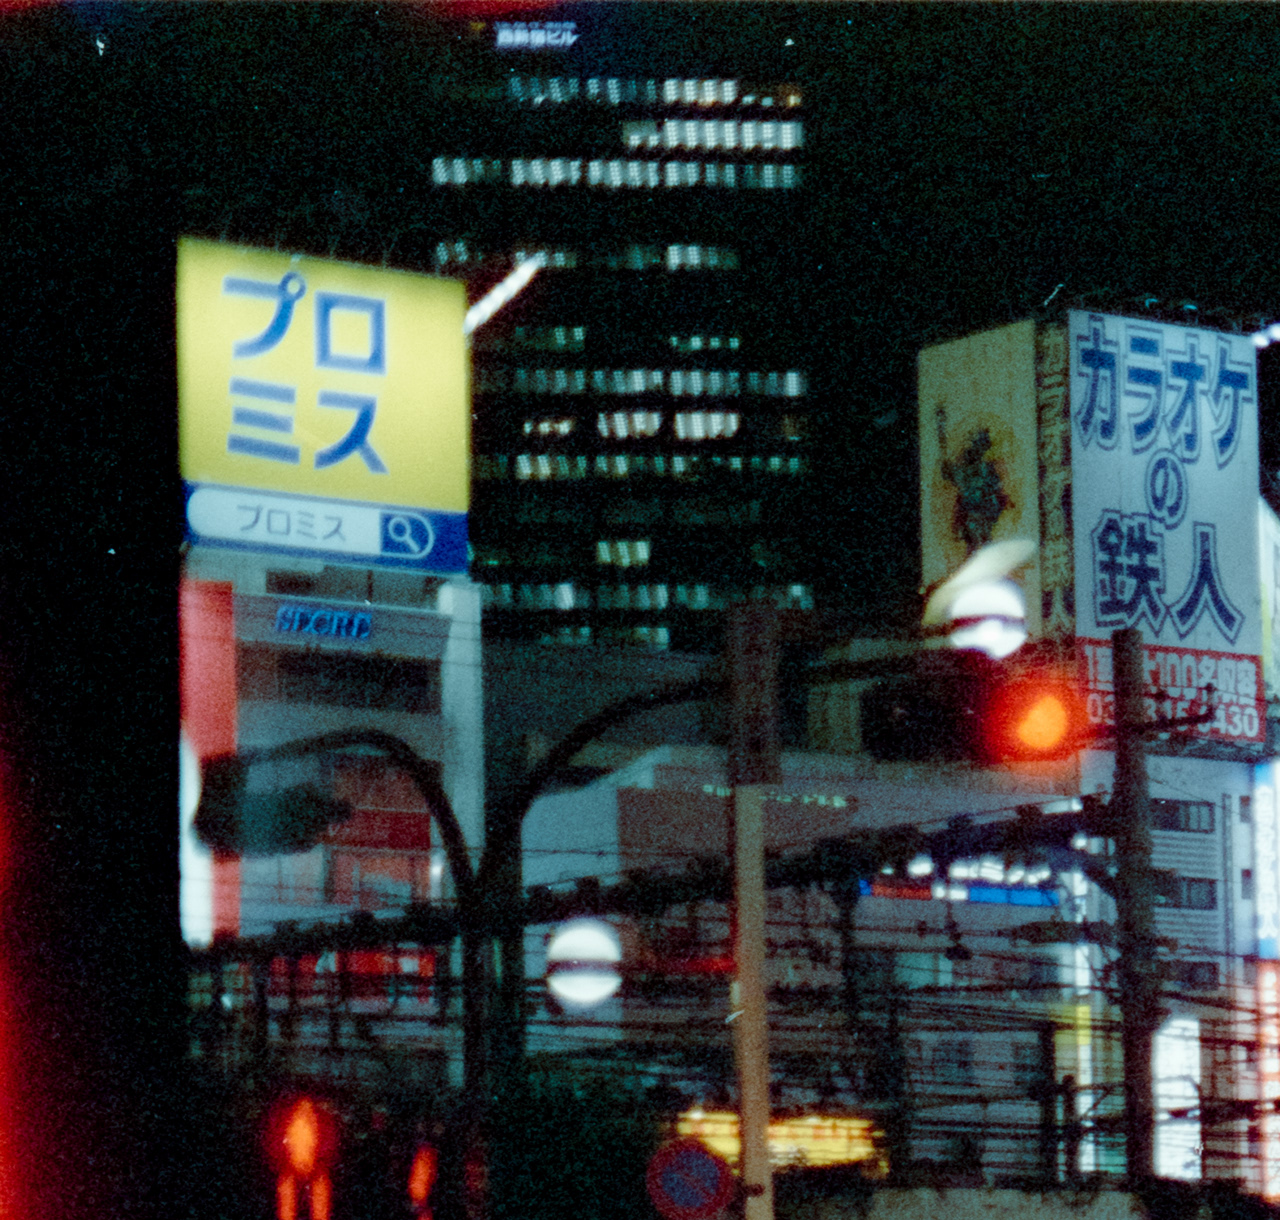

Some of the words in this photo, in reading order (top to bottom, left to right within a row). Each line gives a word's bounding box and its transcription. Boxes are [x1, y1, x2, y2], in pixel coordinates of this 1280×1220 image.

[222, 270, 388, 377] プロ
[226, 375, 390, 476] ミス
[1076, 313, 1253, 470] カラオケ
[236, 504, 346, 542] プロミス
[1145, 447, 1188, 528] の
[1092, 508, 1245, 646] 鉄人
